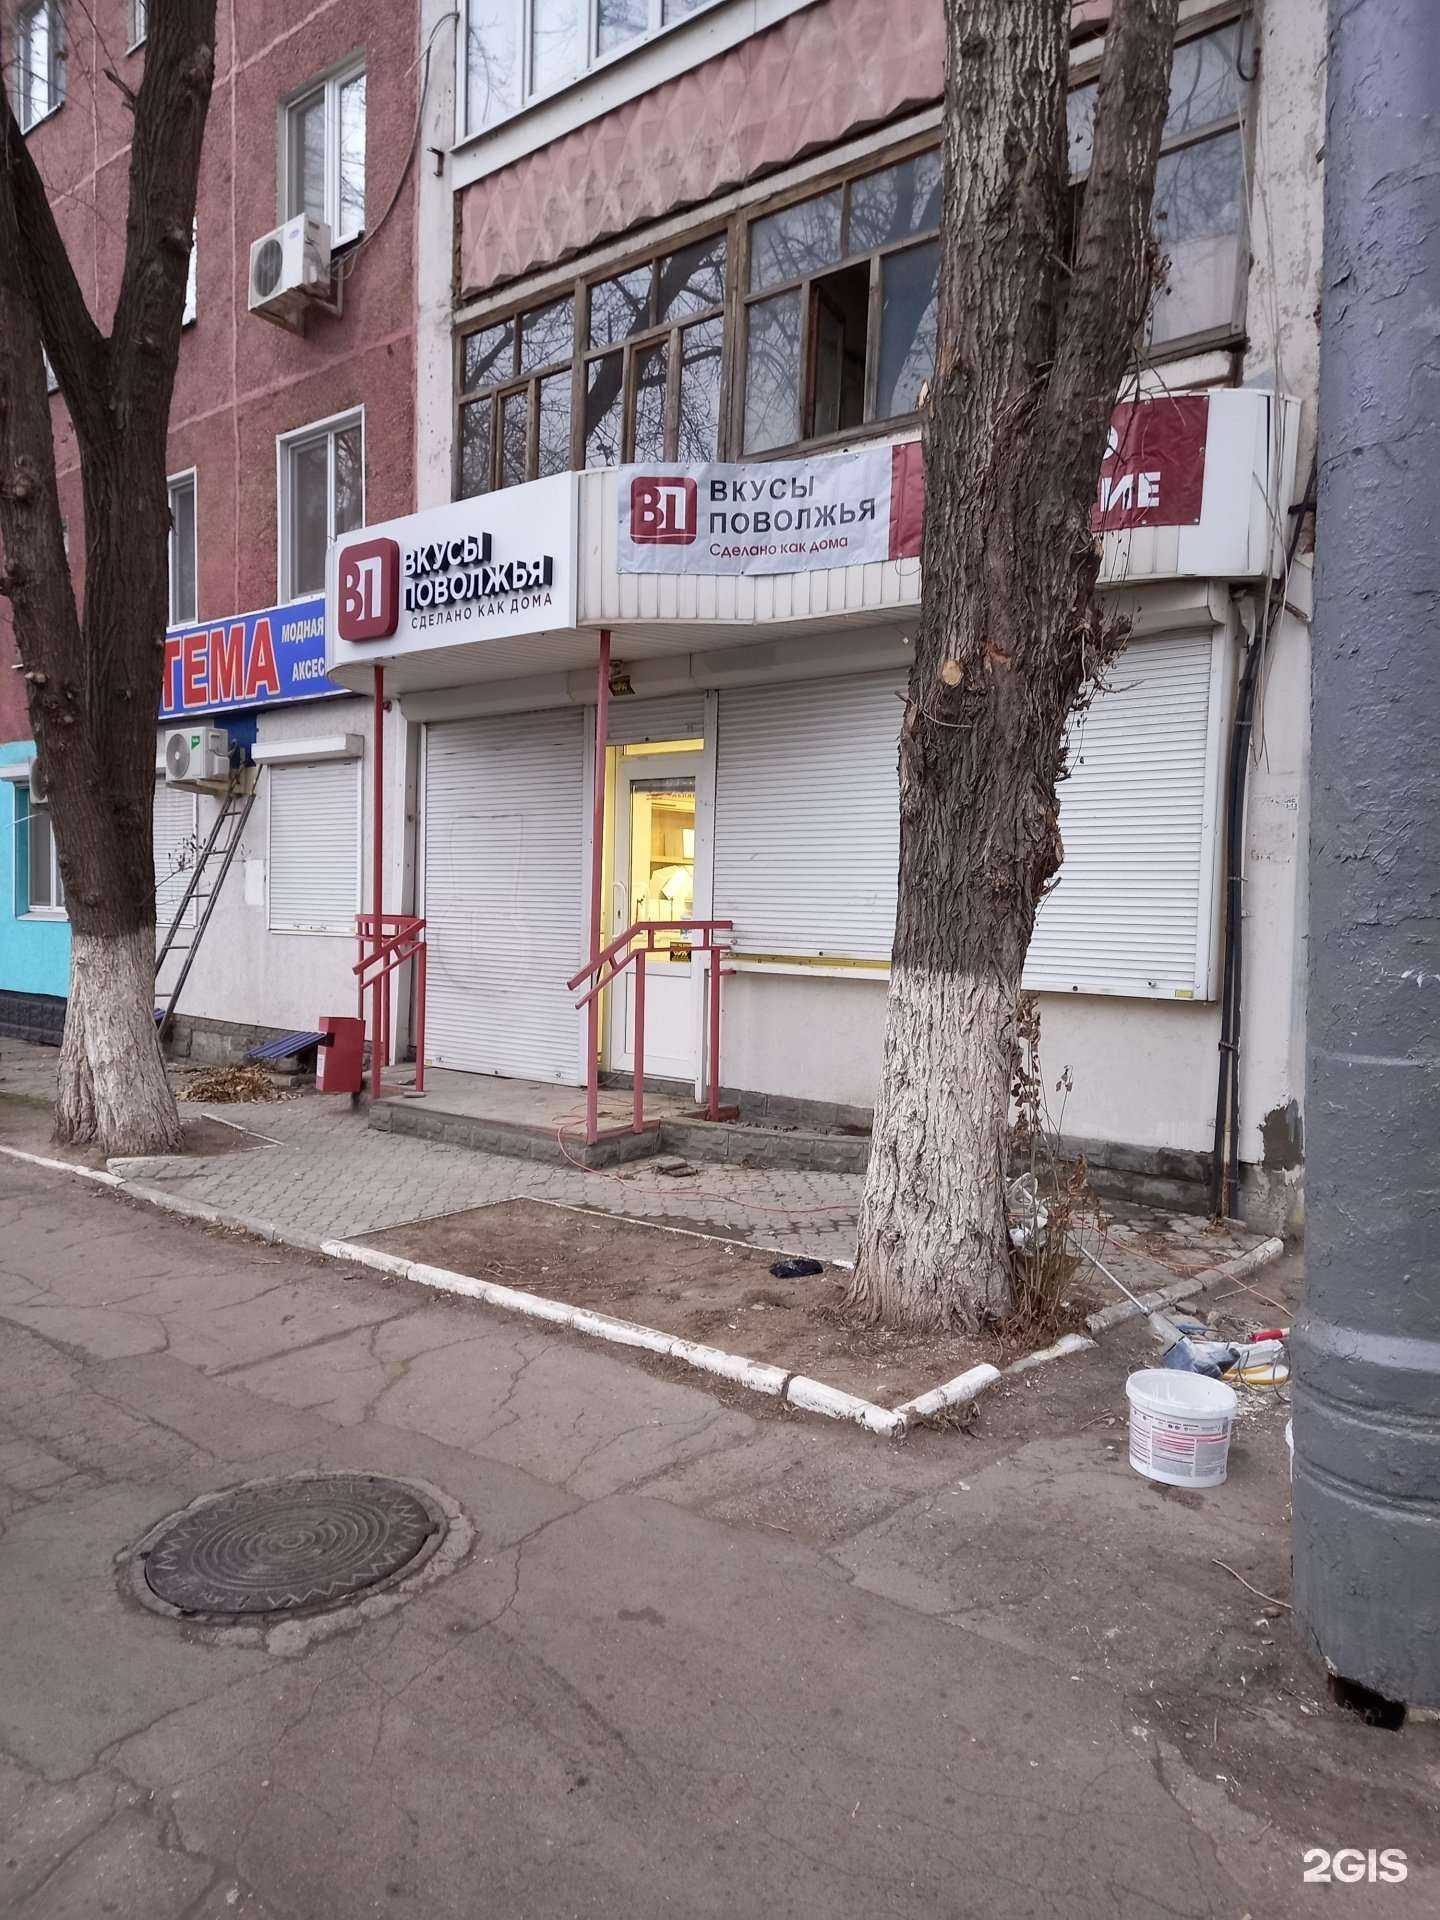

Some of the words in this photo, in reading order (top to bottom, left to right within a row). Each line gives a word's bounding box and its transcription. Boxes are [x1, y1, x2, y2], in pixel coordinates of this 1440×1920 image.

[637, 485, 687, 530] ВП
[709, 475, 815, 503] ВКУСЫ
[1100, 471, 1161, 513] ИЕ
[709, 498, 876, 535] ПОВОЛЖЬЯ
[403, 532, 492, 578] ВКУСЫ
[709, 543, 777, 558] Сделано
[780, 541, 806, 554] как
[809, 537, 848, 554] дома
[343, 555, 382, 622] ВП
[404, 556, 553, 612] ПОВОЛЖЬЯ
[281, 616, 324, 644] МОДНАЯ
[411, 607, 472, 630] СДЕЛАНО
[478, 600, 504, 618] КАК
[510, 592, 552, 614] ДОМА
[292, 657, 325, 682] АКСЕС
